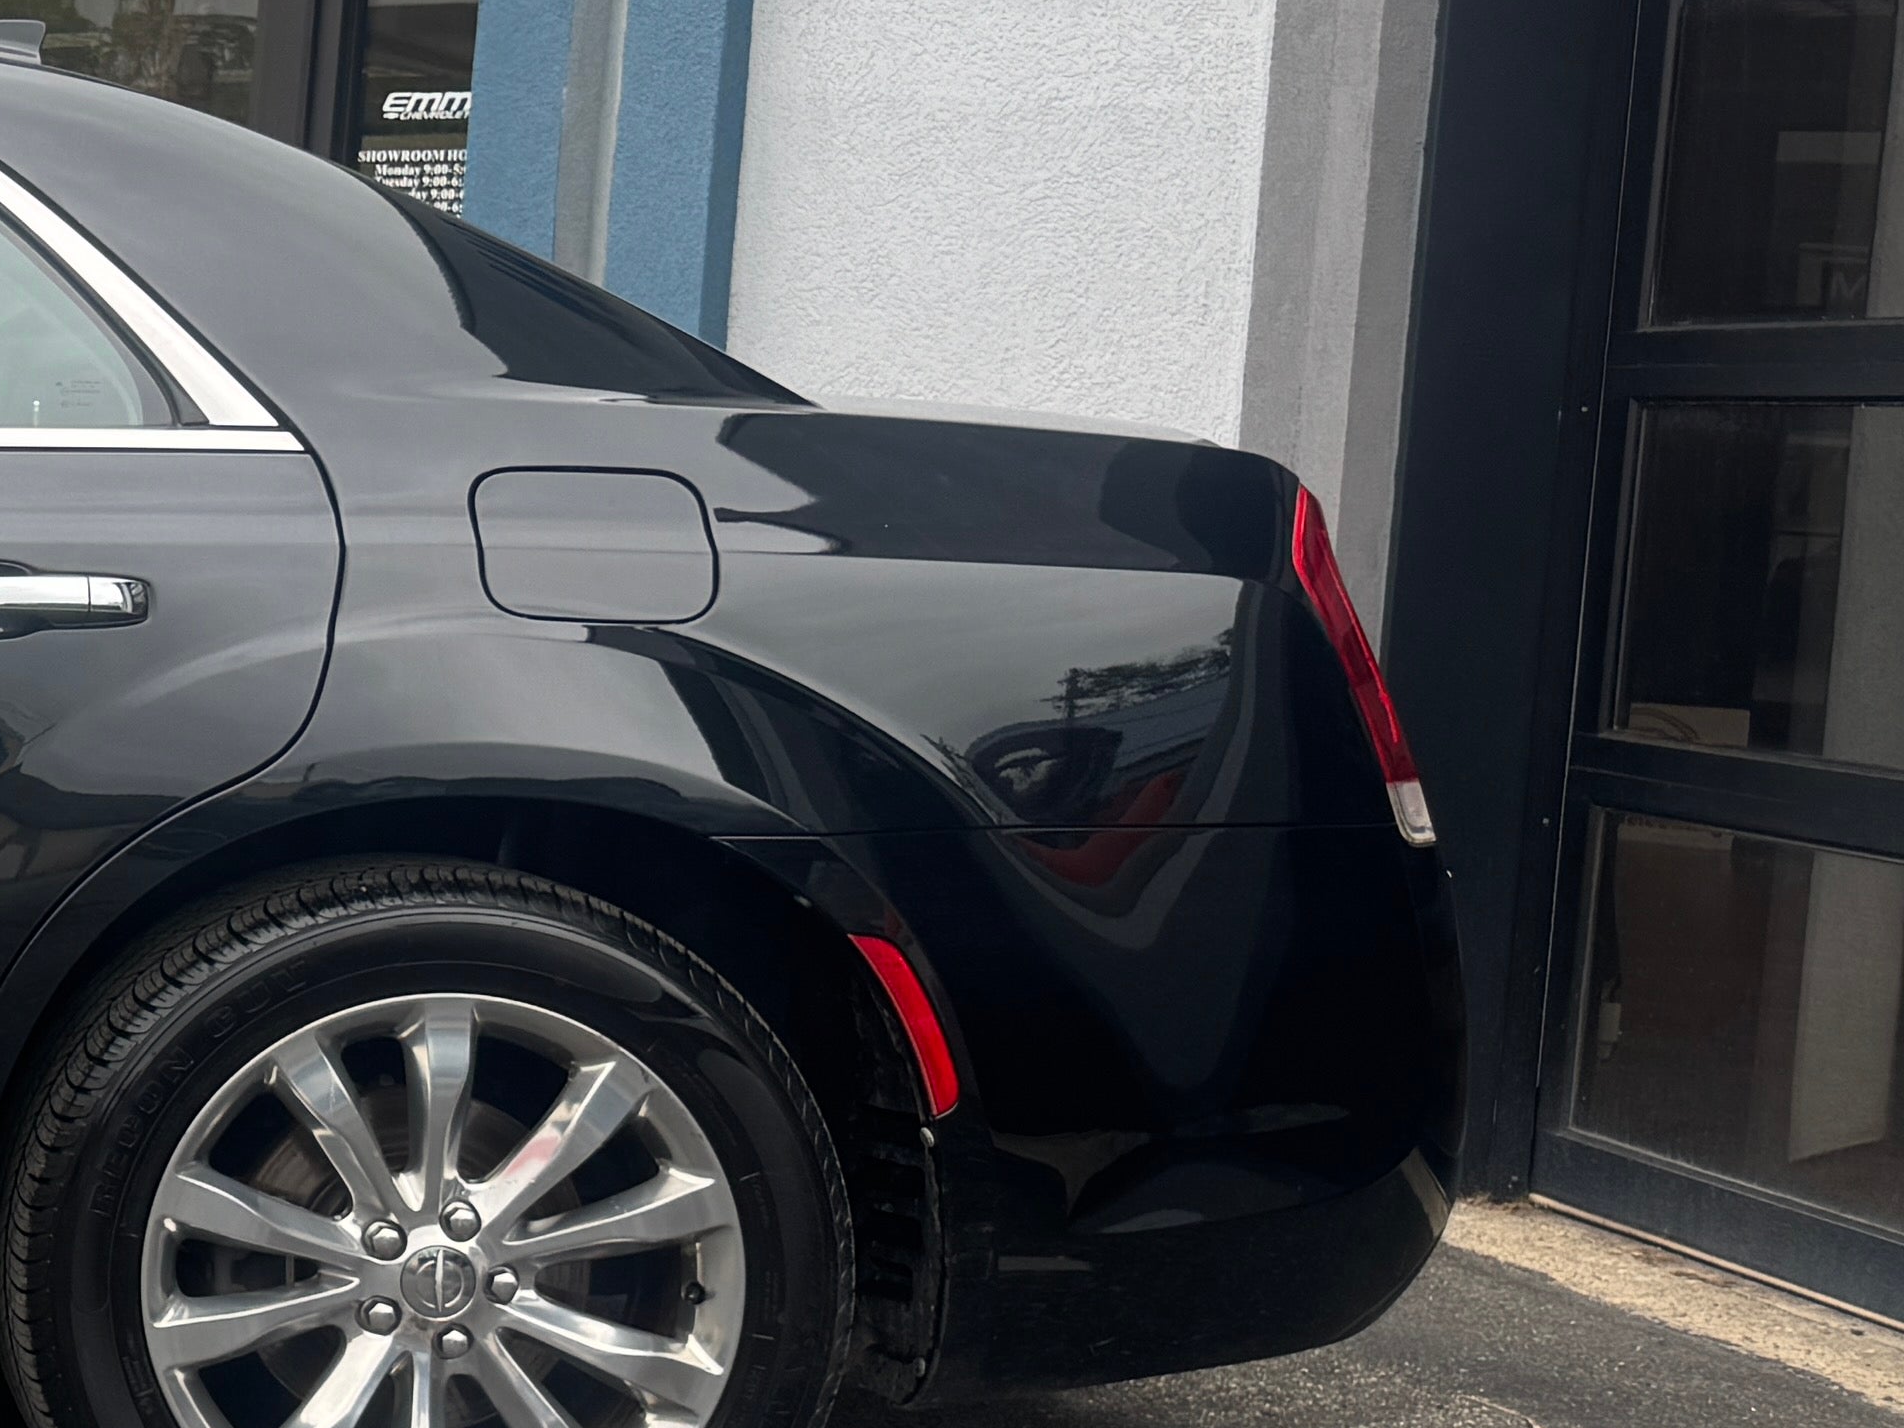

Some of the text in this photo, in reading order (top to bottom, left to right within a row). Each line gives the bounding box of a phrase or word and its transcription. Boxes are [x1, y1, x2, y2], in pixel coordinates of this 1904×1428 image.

[382, 92, 472, 113] EMM
[357, 149, 467, 162] SHOWROOM HO
[375, 164, 421, 177] Monday
